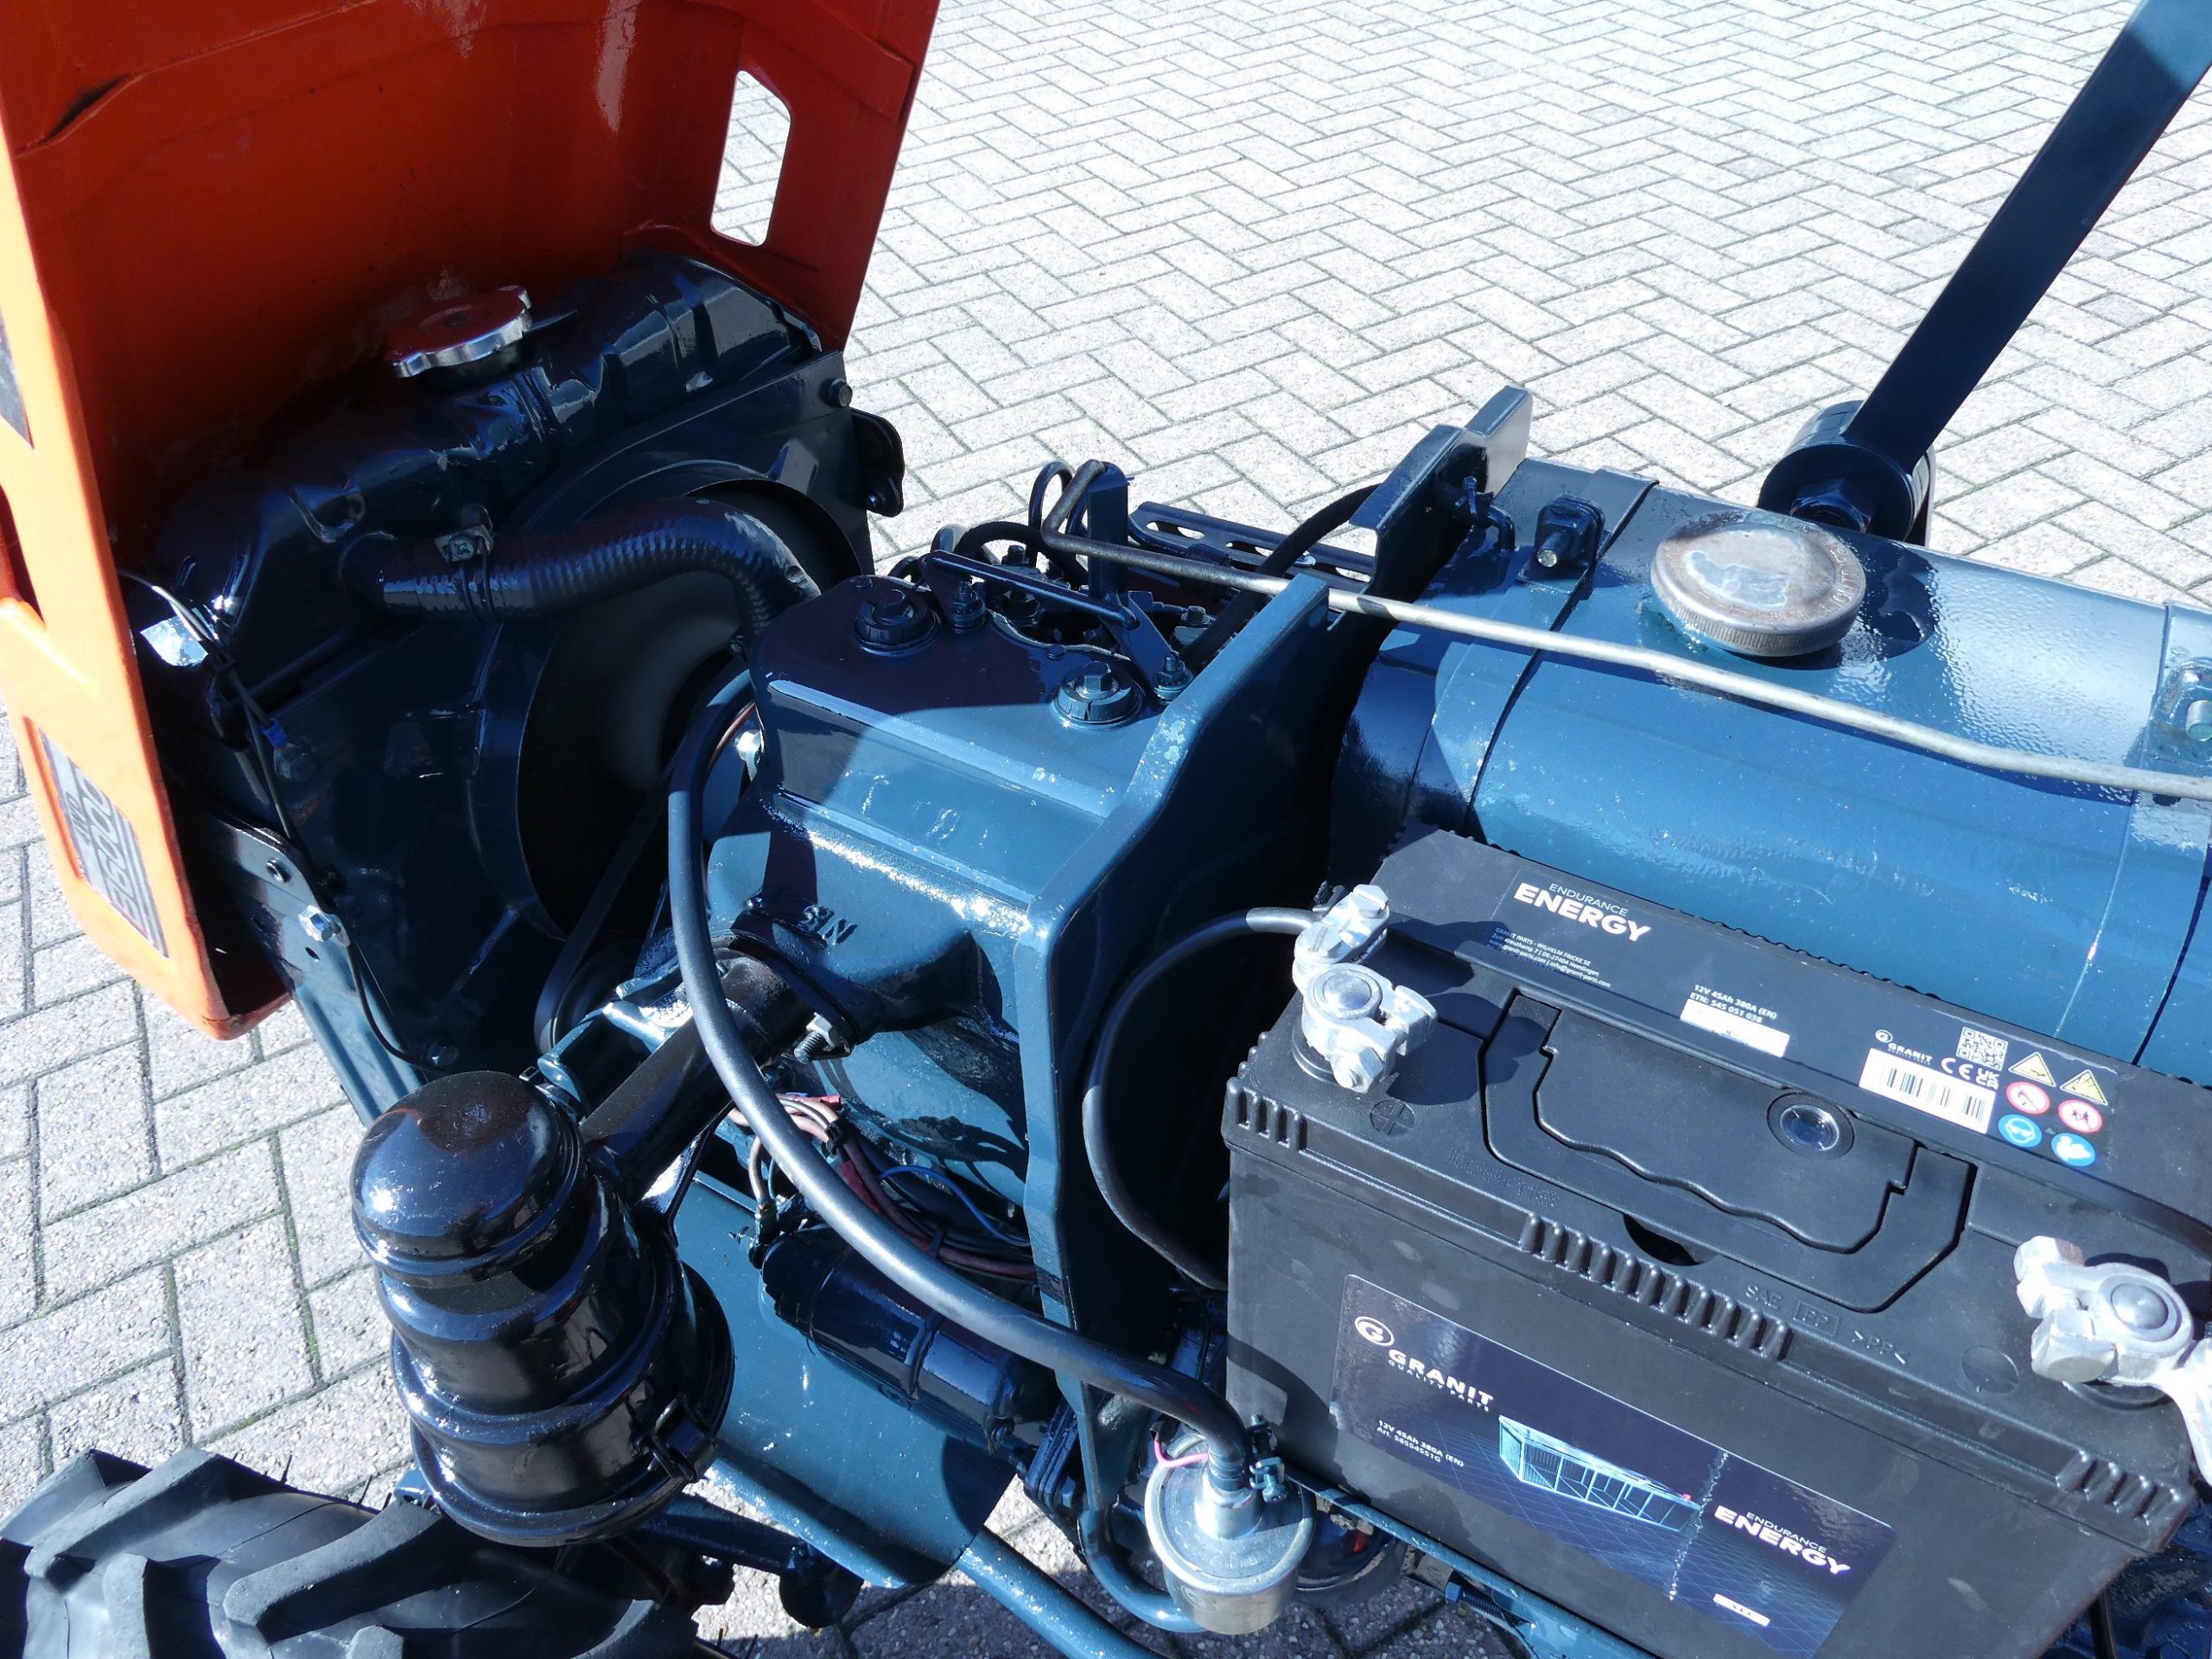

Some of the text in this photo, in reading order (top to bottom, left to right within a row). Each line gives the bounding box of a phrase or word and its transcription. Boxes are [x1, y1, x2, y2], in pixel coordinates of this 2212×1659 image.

[1513, 882, 1651, 942] ENERGY
[1549, 883, 1629, 917] ENDURANCE
[1516, 934, 1534, 945] PARTS
[1689, 992, 1709, 1003] ETN:
[1710, 1000, 1727, 1010] 545
[1694, 984, 1777, 1020] 12V 45Ah 380A (EN)
[1887, 1042, 1933, 1062] GRANIT
[1941, 1058, 1974, 1081] CE
[1388, 1359, 1490, 1412] QUALITY PARTS
[1389, 1349, 1494, 1405] GRANIT
[1376, 1427, 1392, 1439] Art.
[1378, 1420, 1465, 1467] 12V 45Ah 380A (EN)
[1714, 1505, 1851, 1575] ENERGY
[1746, 1512, 1827, 1554] ENDURANCE
